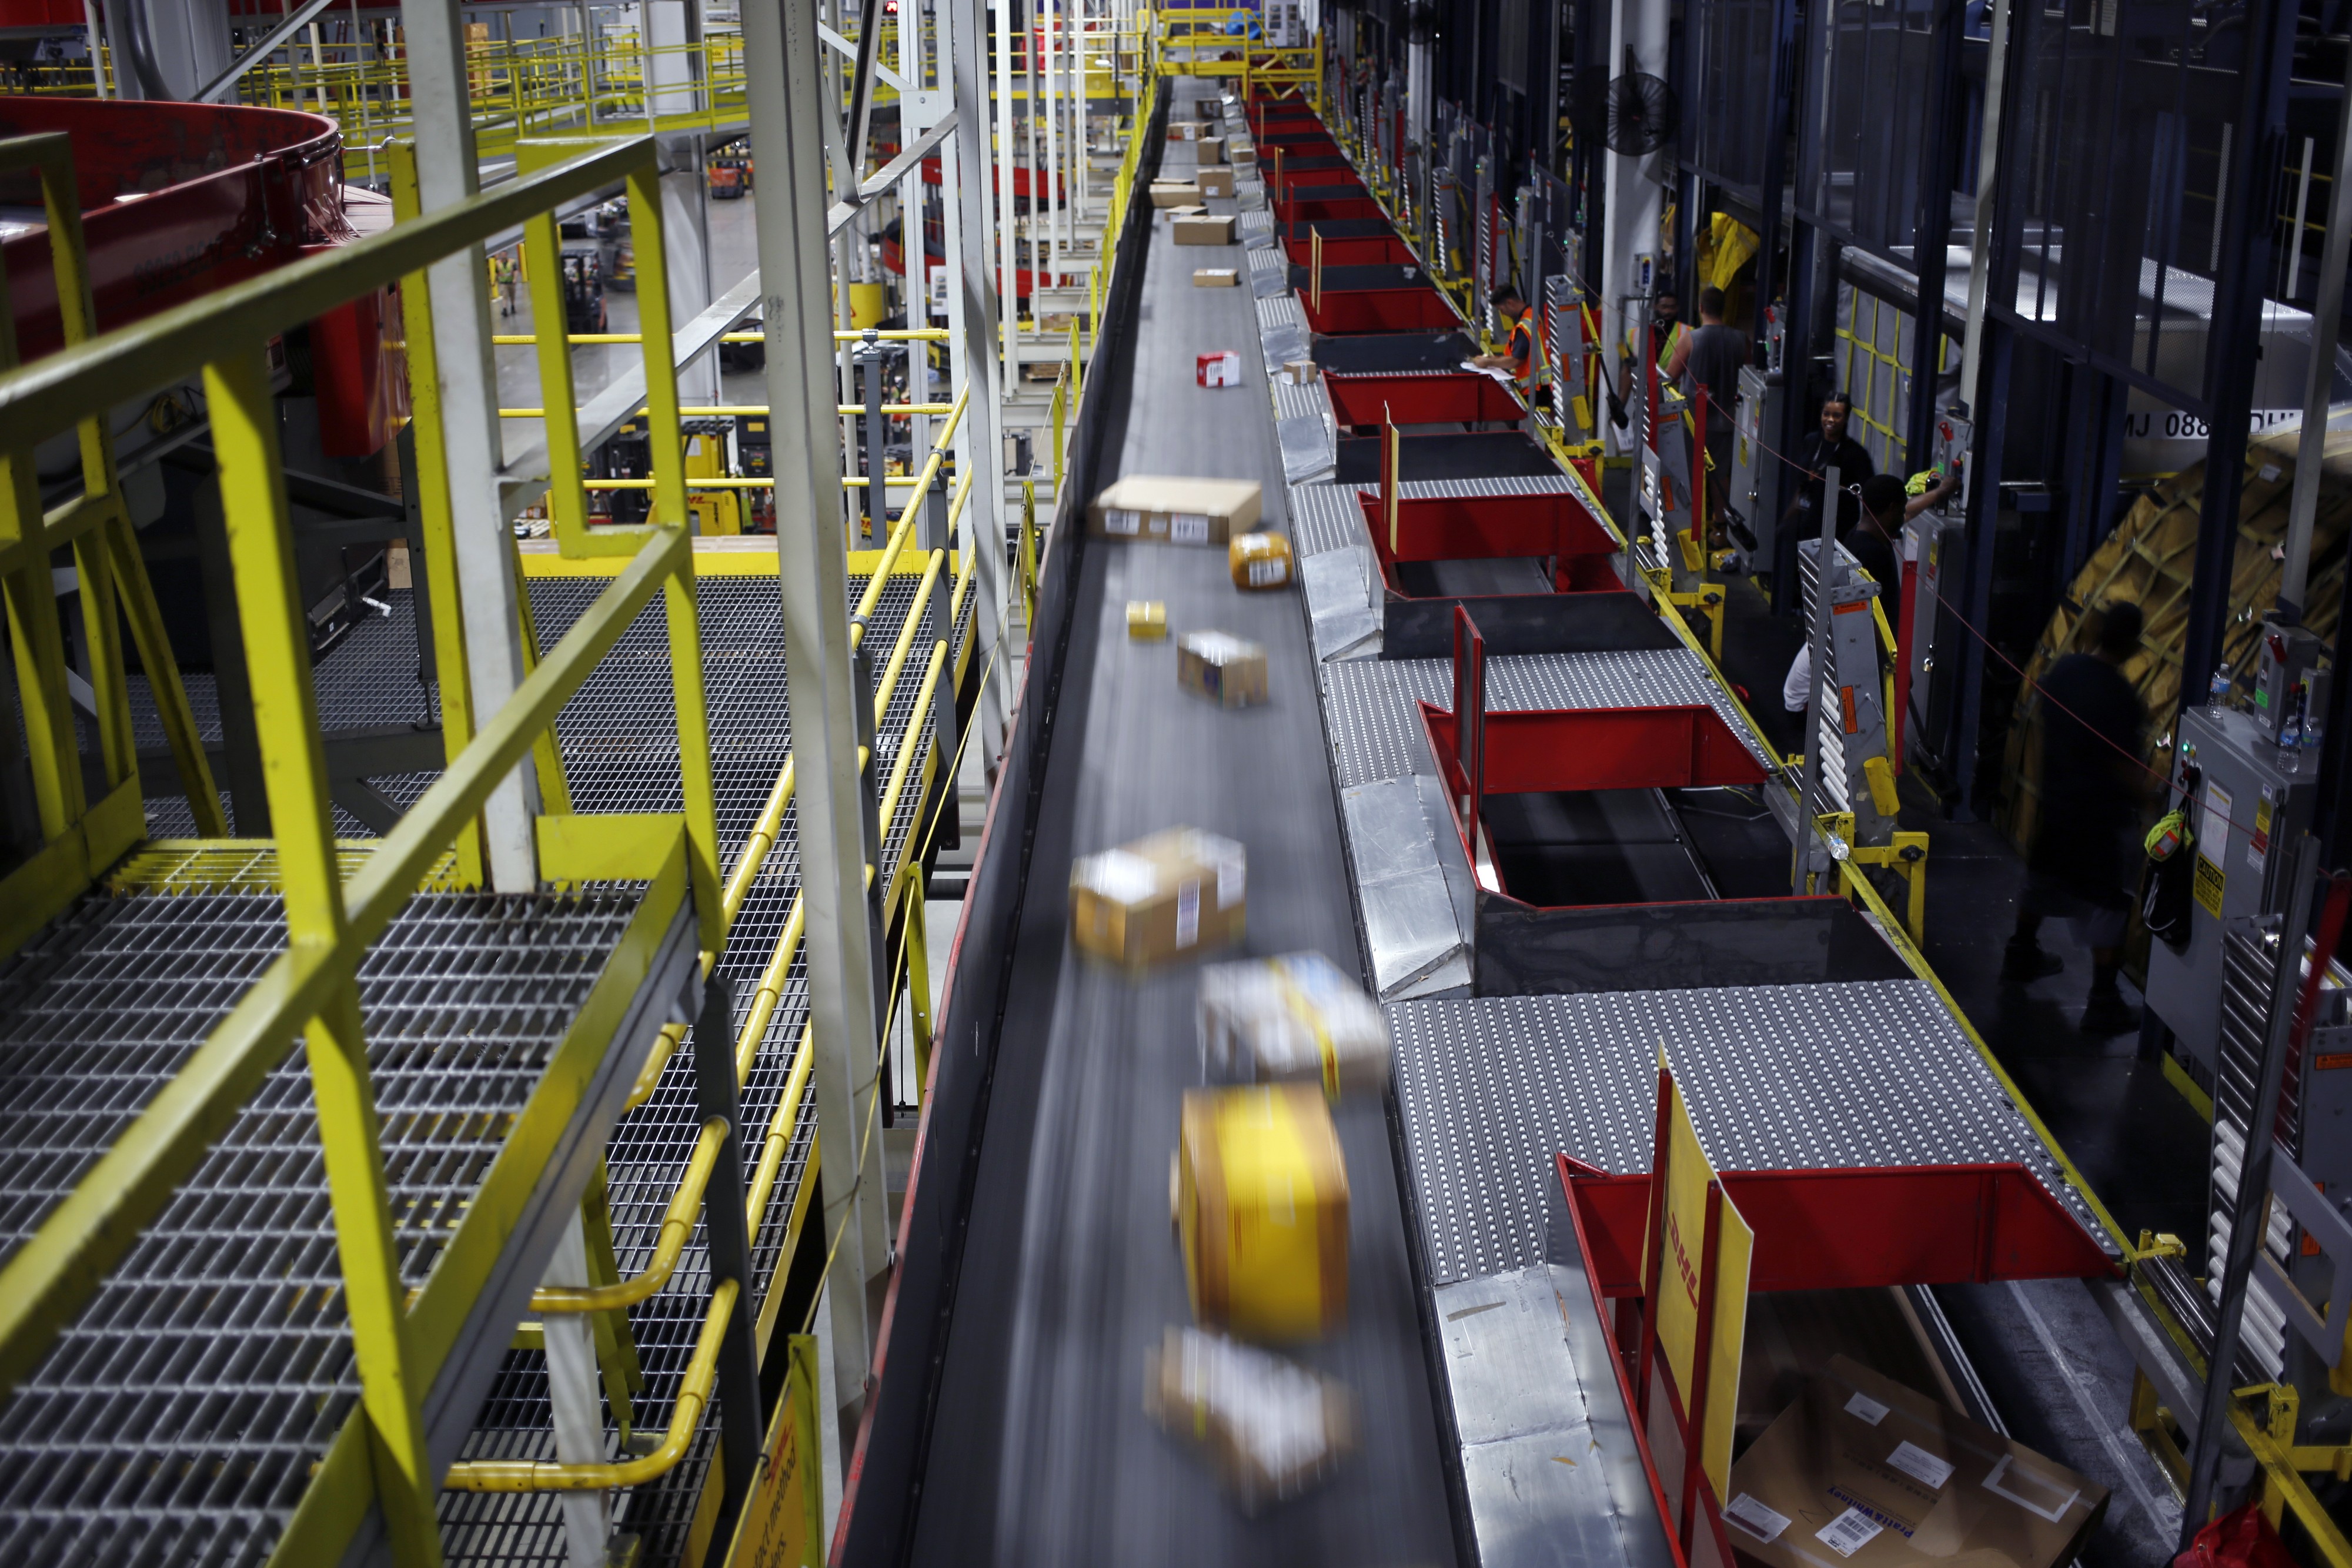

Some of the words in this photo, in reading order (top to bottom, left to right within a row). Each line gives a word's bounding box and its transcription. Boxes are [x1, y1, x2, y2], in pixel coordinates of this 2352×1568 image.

[2198, 859, 2223, 889] CAUTION
[1671, 1211, 1698, 1312] DHL
[770, 1435, 796, 1533] method
